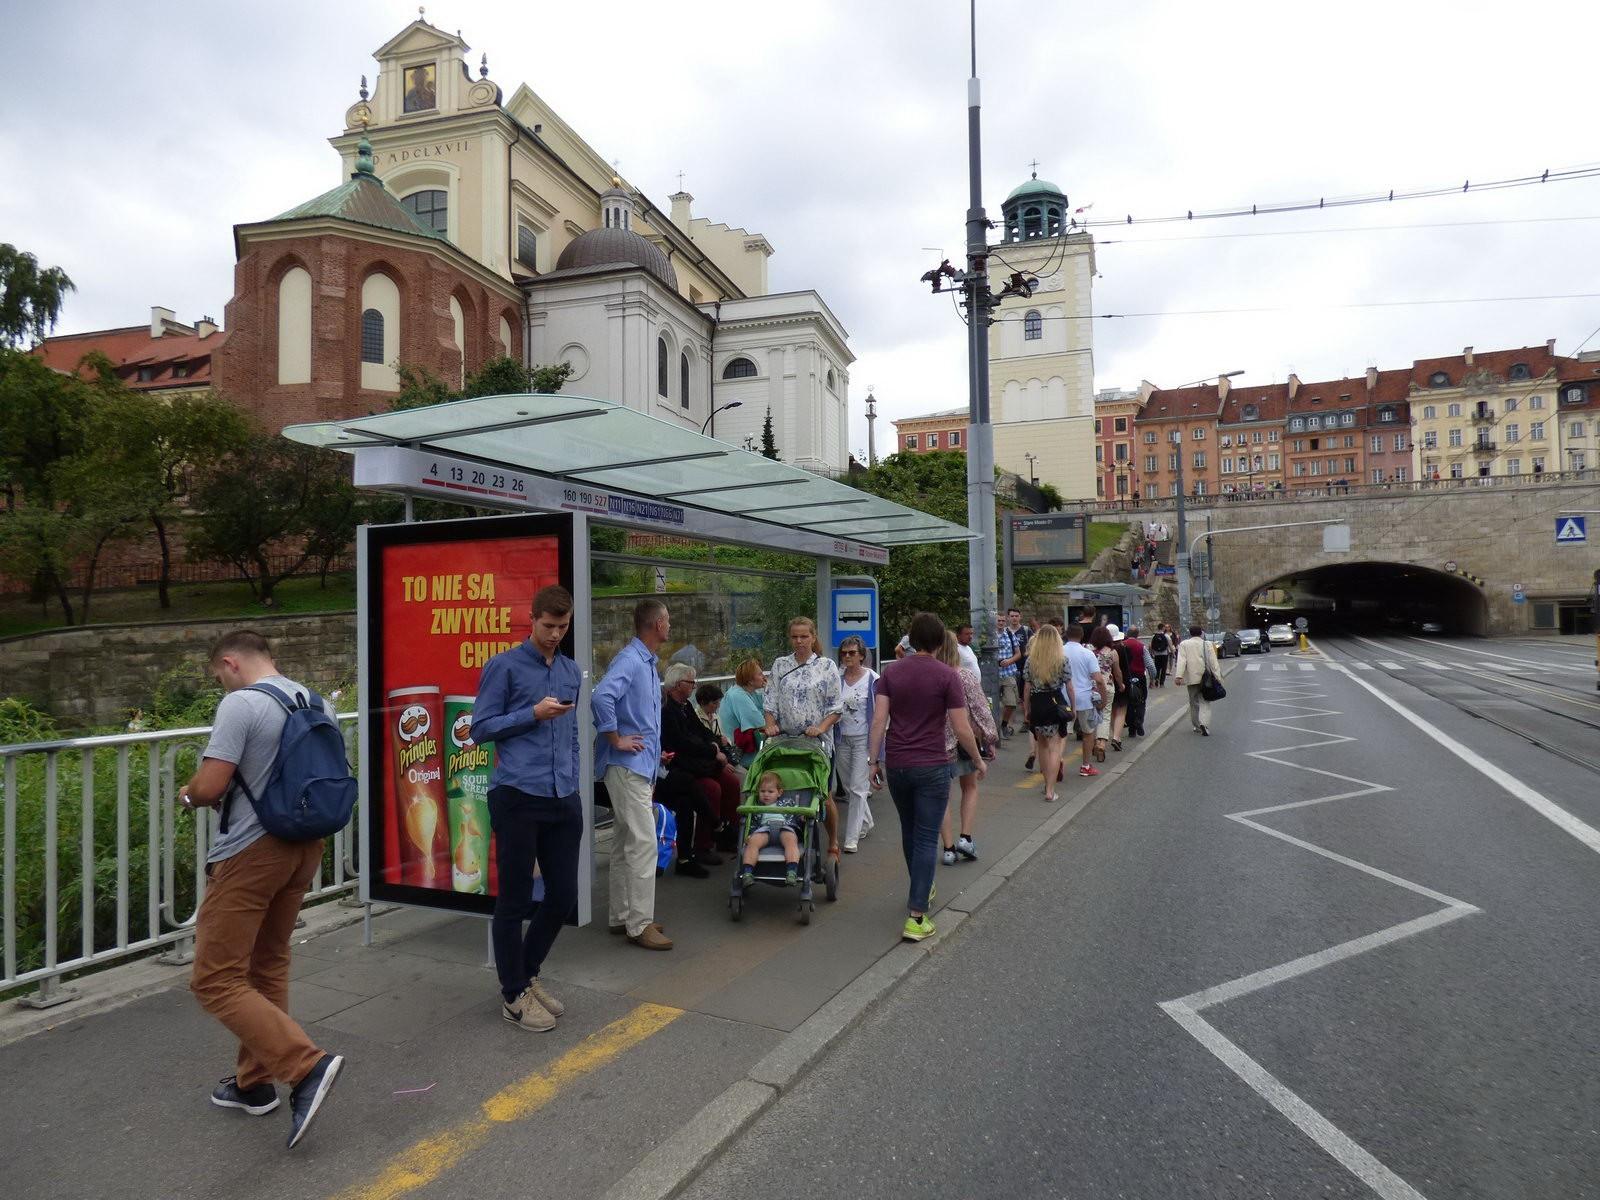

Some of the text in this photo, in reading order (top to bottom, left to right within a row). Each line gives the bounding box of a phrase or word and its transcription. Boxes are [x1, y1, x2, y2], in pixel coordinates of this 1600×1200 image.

[389, 140, 468, 163] MDCLXVII
[430, 463, 525, 493] 4 13 20 23 26
[563, 489, 577, 503] 160
[579, 492, 593, 505] 190
[594, 495, 608, 508] 527
[401, 573, 496, 604] TO NIE SĄ
[430, 606, 512, 634] ZWYKŁE
[459, 640, 524, 669] CHI
[399, 735, 438, 776] Pringles
[448, 744, 489, 780] Pringles
[462, 774, 488, 785] SOUR
